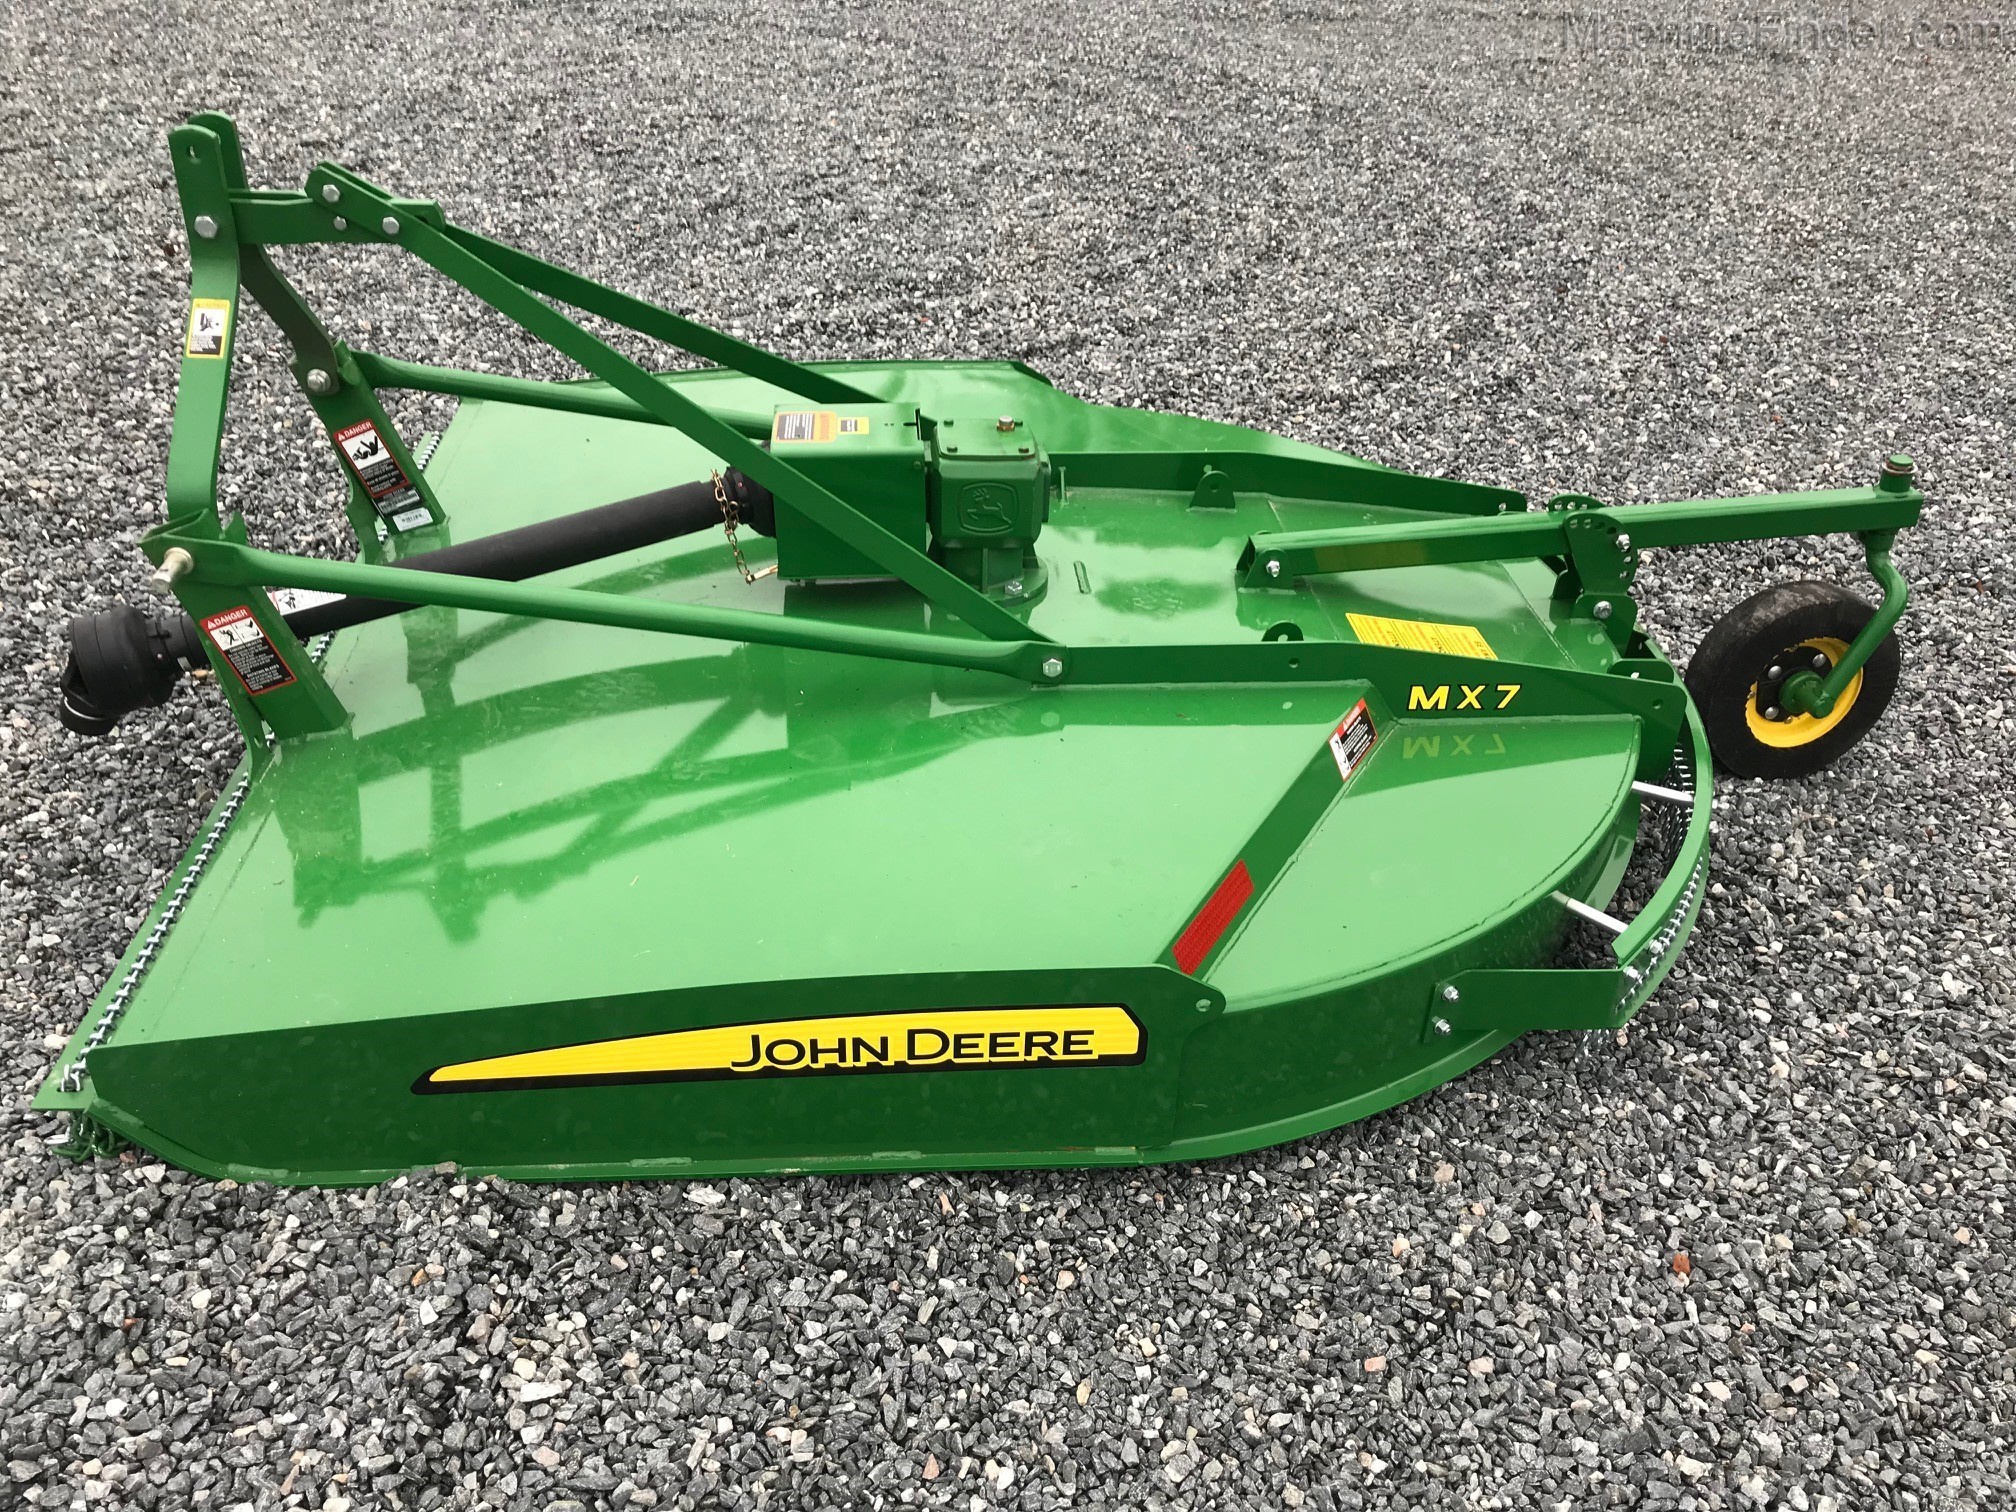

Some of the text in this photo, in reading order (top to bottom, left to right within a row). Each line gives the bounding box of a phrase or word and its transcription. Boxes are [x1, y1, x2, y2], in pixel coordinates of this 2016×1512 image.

[345, 422, 372, 437] DANGER
[214, 608, 248, 627] DANGER
[731, 1027, 1097, 1070] JOHN DEERE
